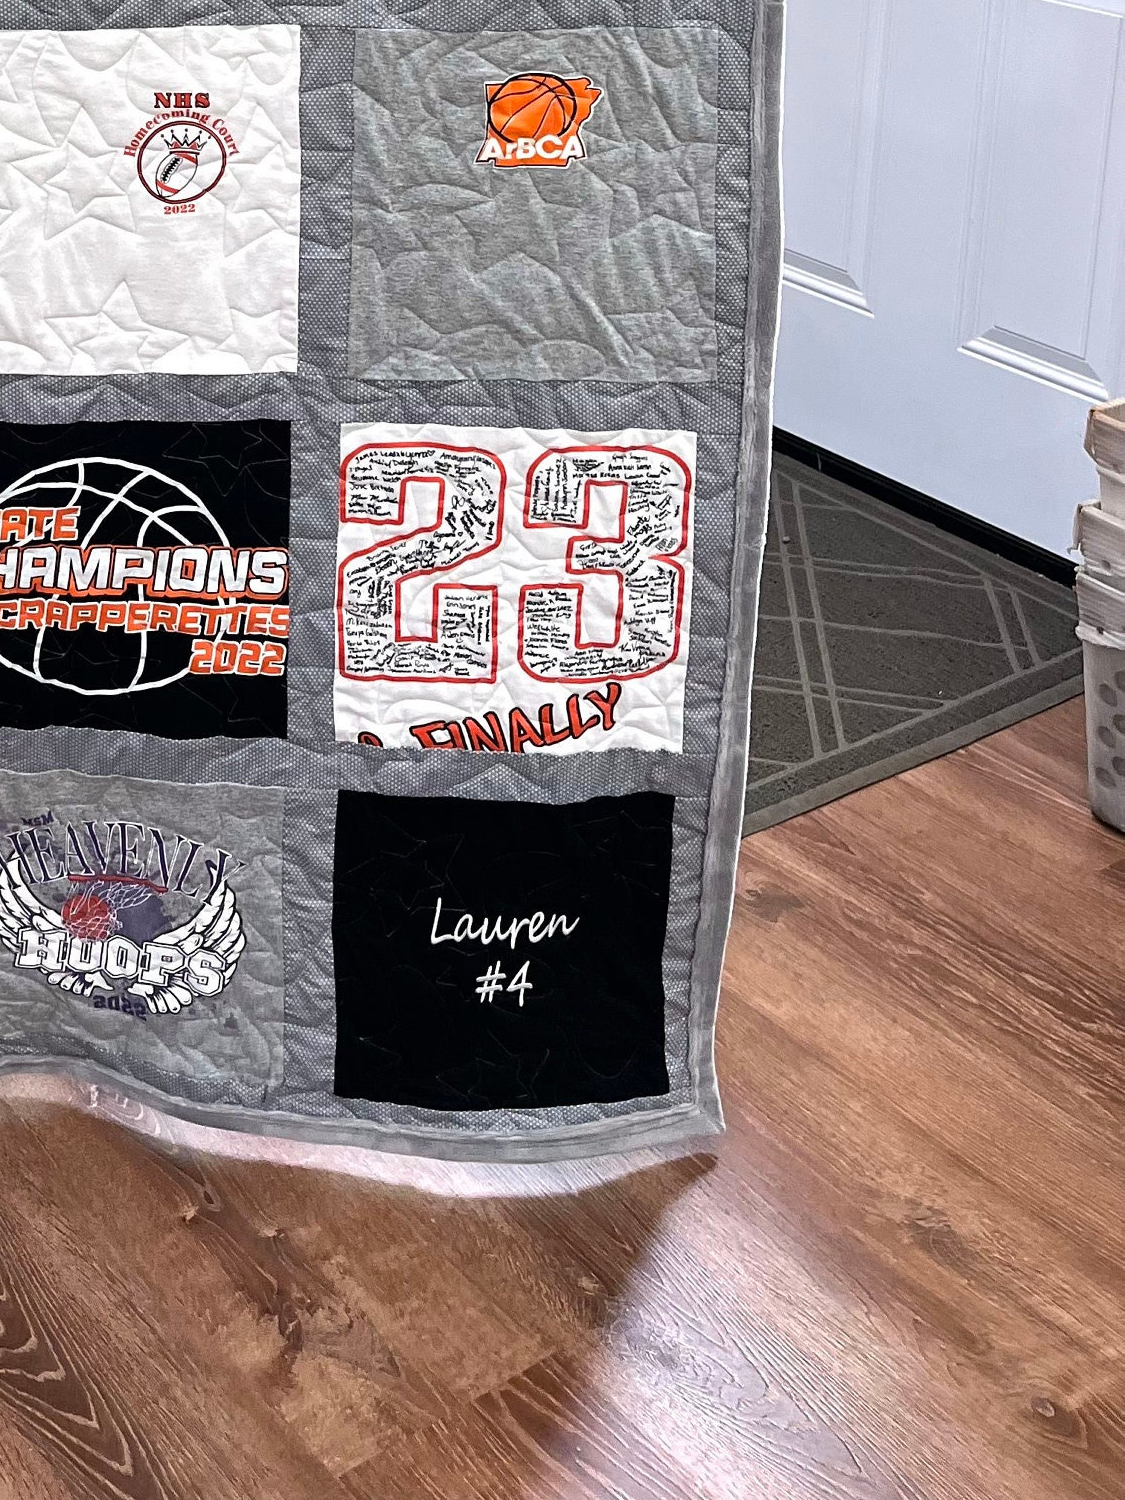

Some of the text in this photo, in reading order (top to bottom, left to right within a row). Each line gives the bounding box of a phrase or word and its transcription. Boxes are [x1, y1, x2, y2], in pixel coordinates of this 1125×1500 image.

[153, 92, 211, 109] NHS
[211, 118, 240, 157] Court
[477, 134, 585, 161] ArBCA
[163, 203, 196, 215] 2022
[188, 640, 287, 676] 2022
[430, 896, 580, 950] Lauren
[15, 927, 226, 997] HOOPS
[475, 960, 534, 1007] #4
